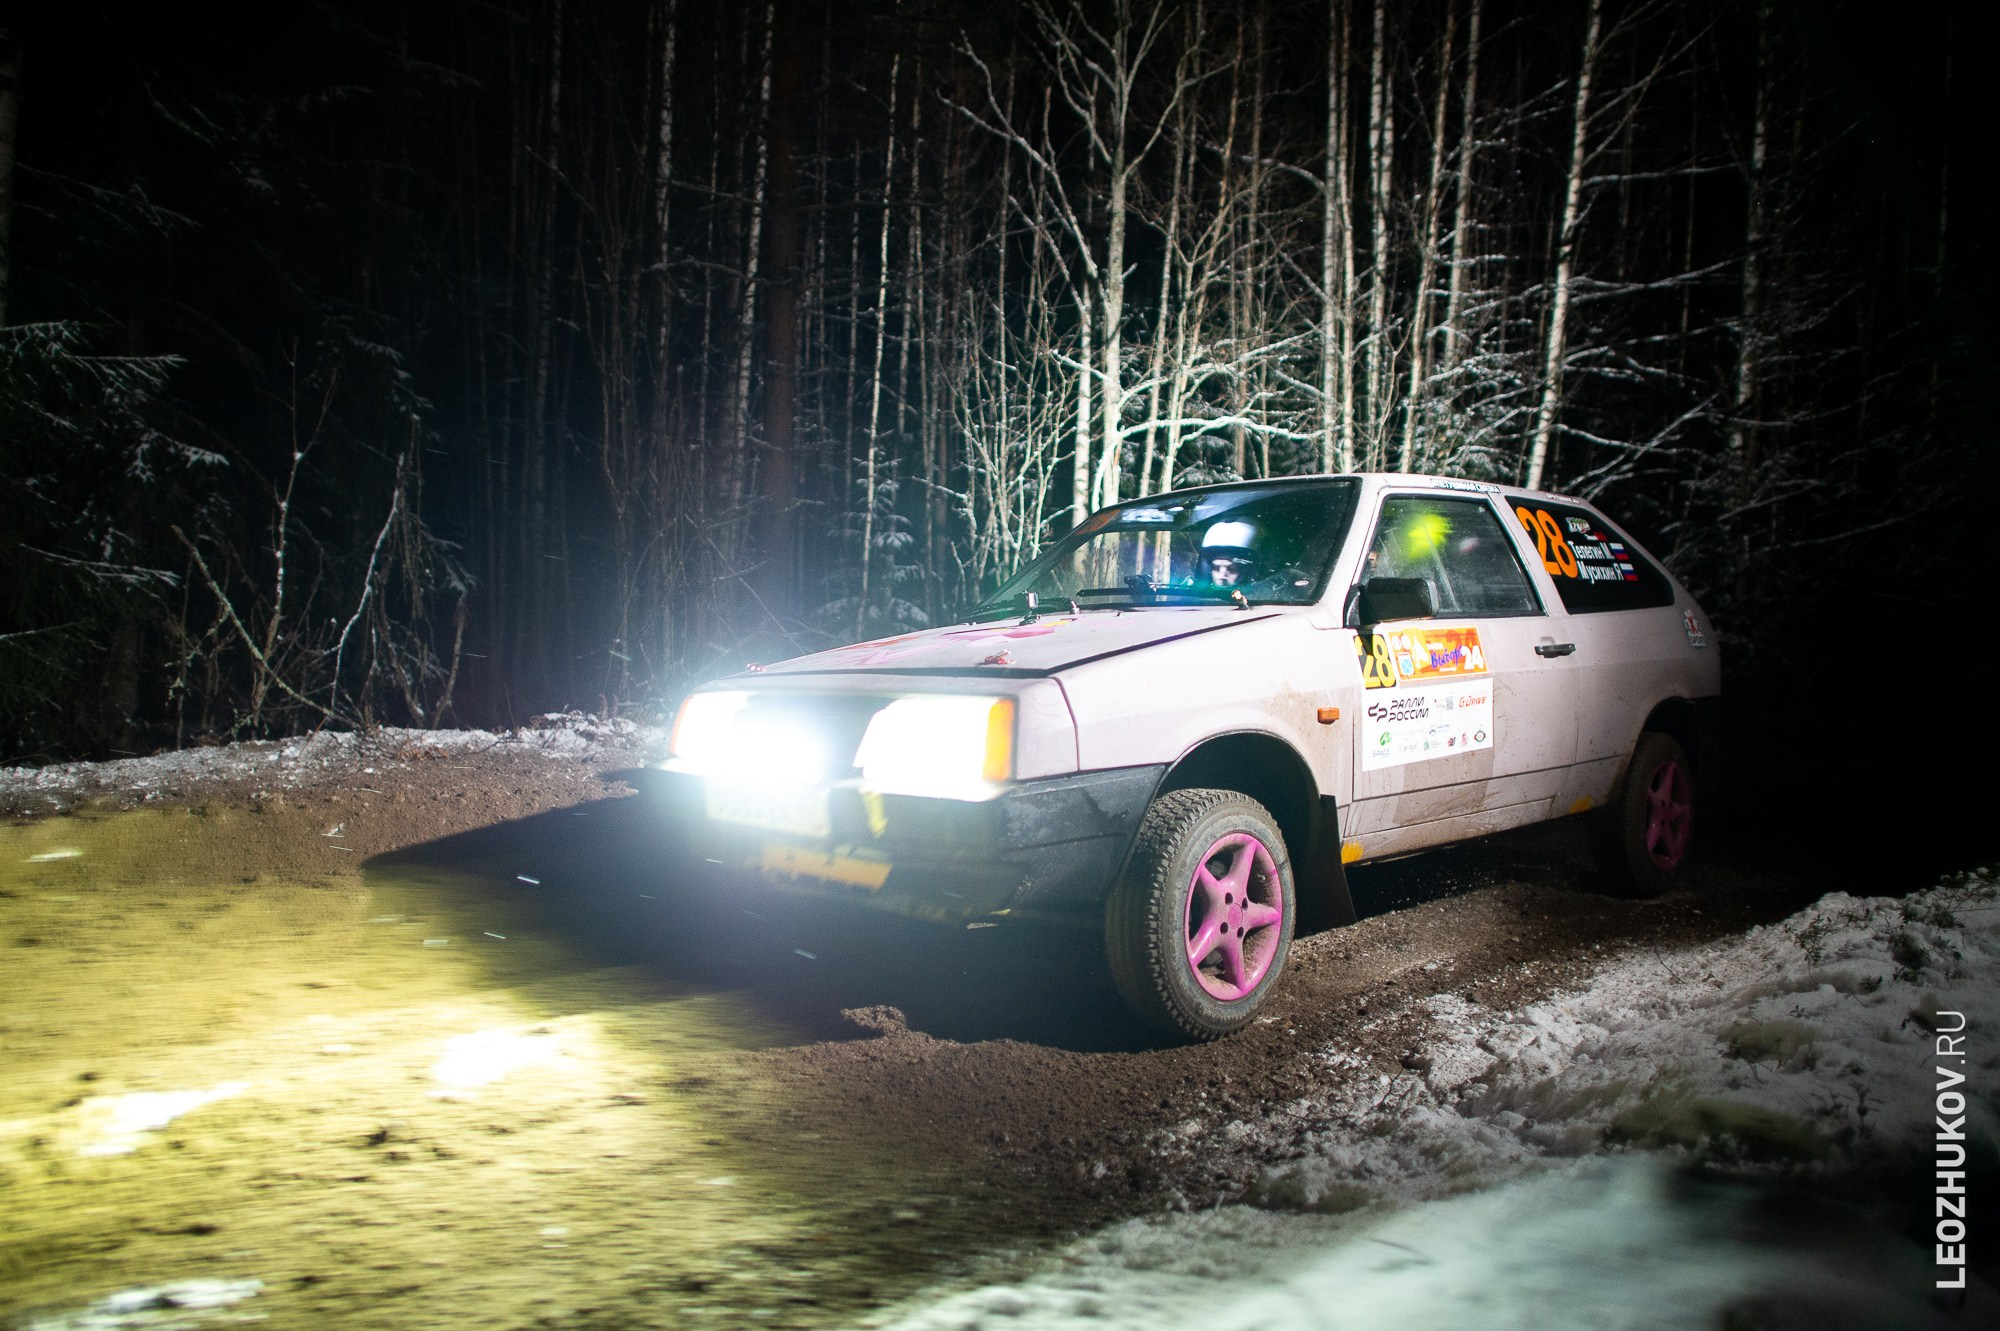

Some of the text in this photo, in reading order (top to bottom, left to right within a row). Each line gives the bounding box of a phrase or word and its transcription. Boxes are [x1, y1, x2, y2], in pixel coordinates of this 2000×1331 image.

[1516, 507, 1579, 579] 28
[1576, 560, 1625, 585] Мусихин Я
[1354, 634, 1396, 688] 28
[1460, 645, 1485, 670] 24
[1388, 707, 1430, 723] РОССИИ
[1390, 696, 1426, 711] РАЛЛИ
